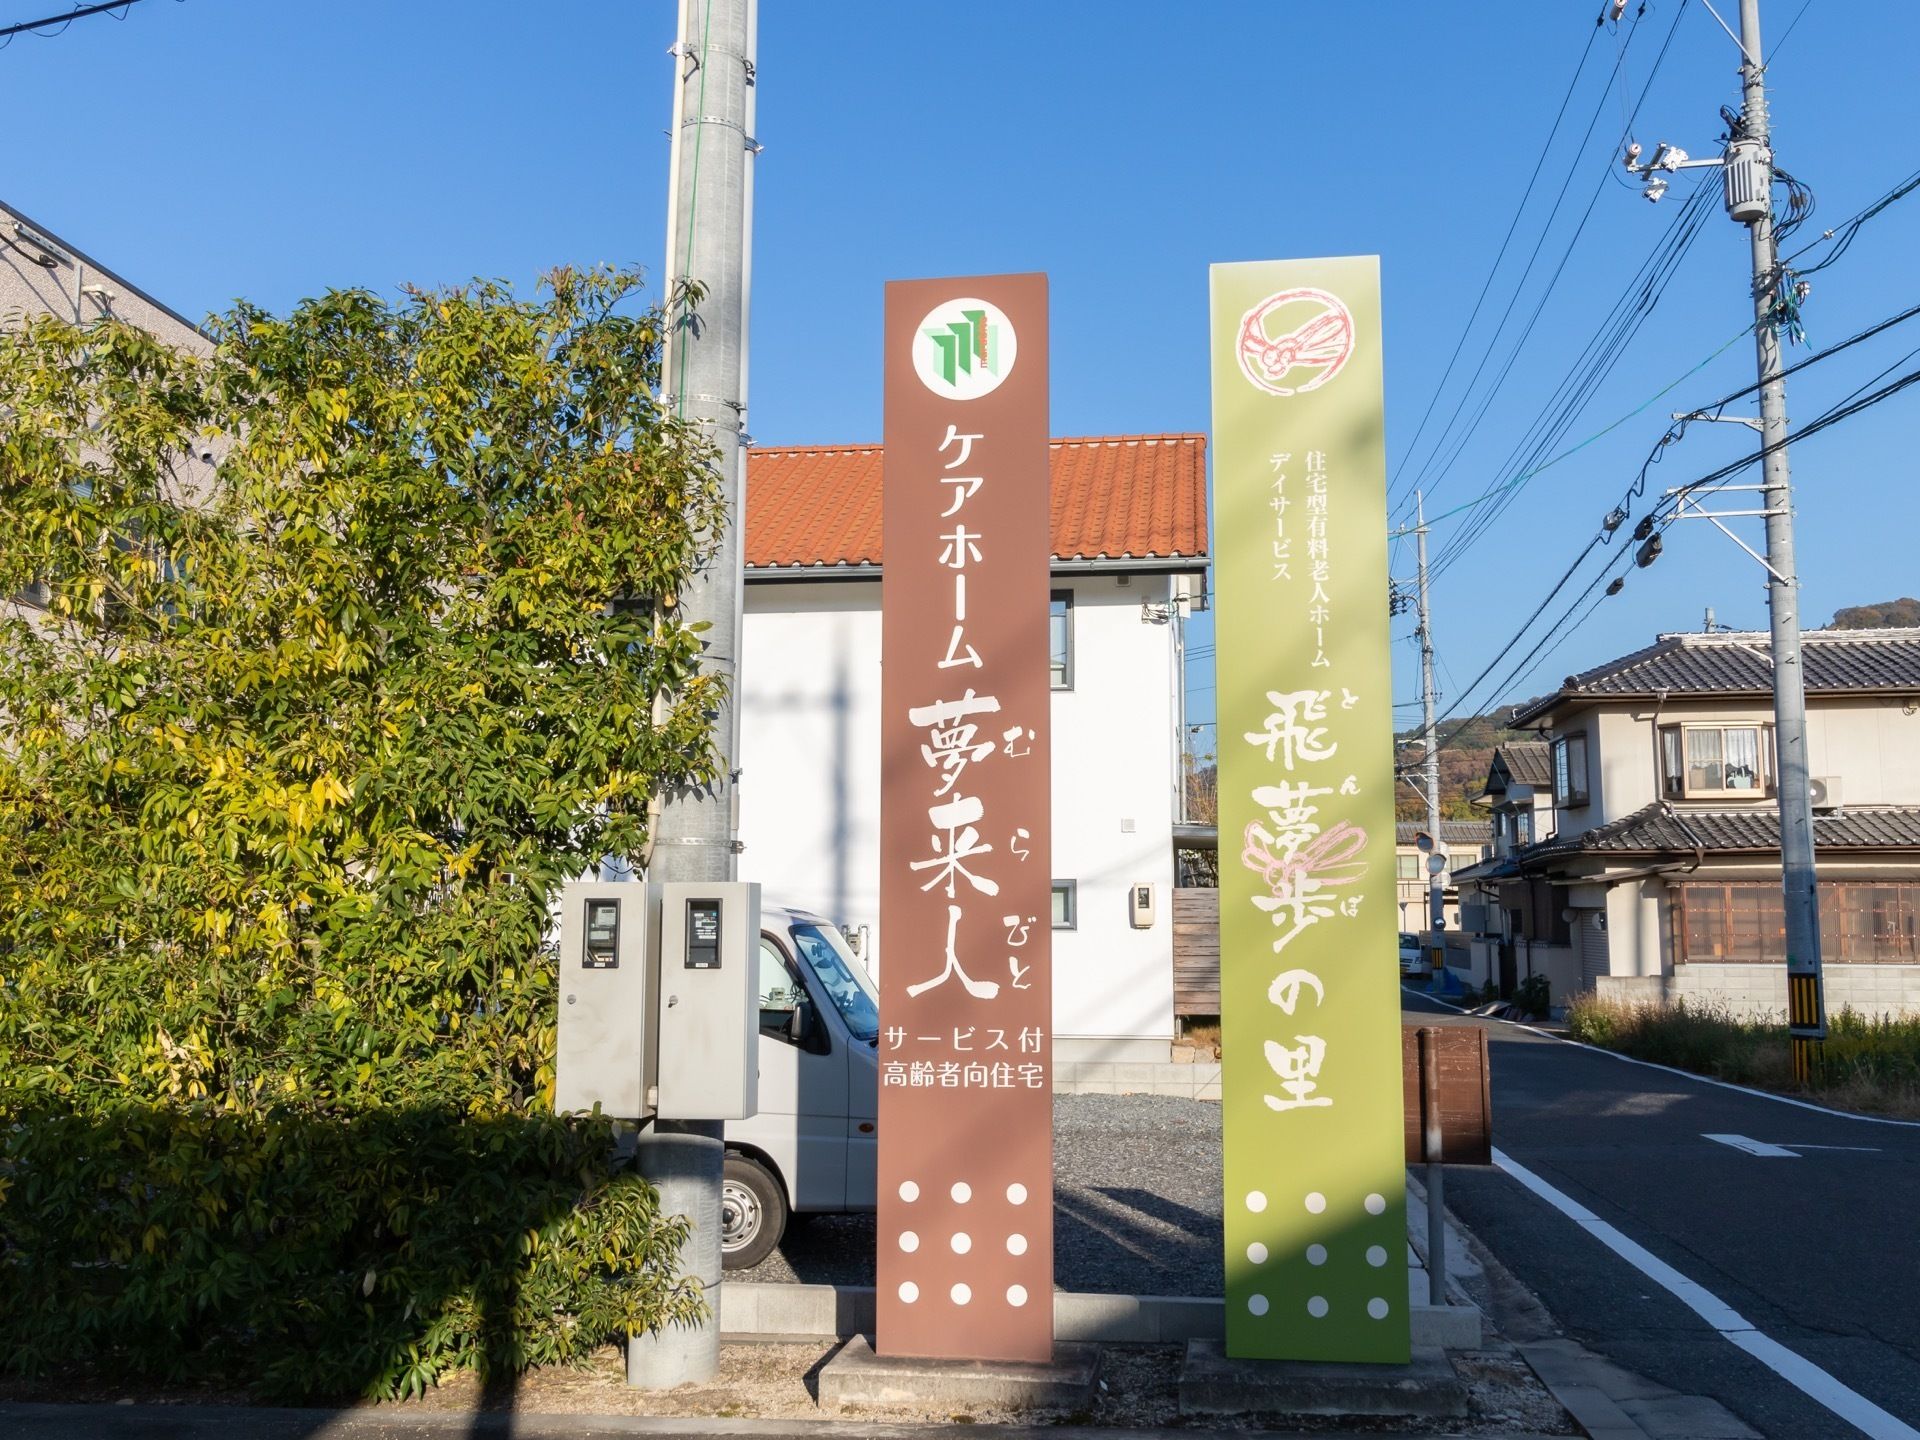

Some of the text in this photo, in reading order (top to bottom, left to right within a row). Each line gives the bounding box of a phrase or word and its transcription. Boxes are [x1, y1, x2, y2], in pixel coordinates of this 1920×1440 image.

[938, 425, 984, 668] ケアホーム
[1269, 453, 1291, 580] デイサービス
[1305, 451, 1331, 667] 住宅型有料老人ホーム
[907, 689, 1001, 999] 夢来人
[1244, 691, 1338, 1111] 飛夢歩の里
[884, 1061, 1044, 1089] 高齢者向住宅
[885, 1027, 1044, 1053] サービス付
